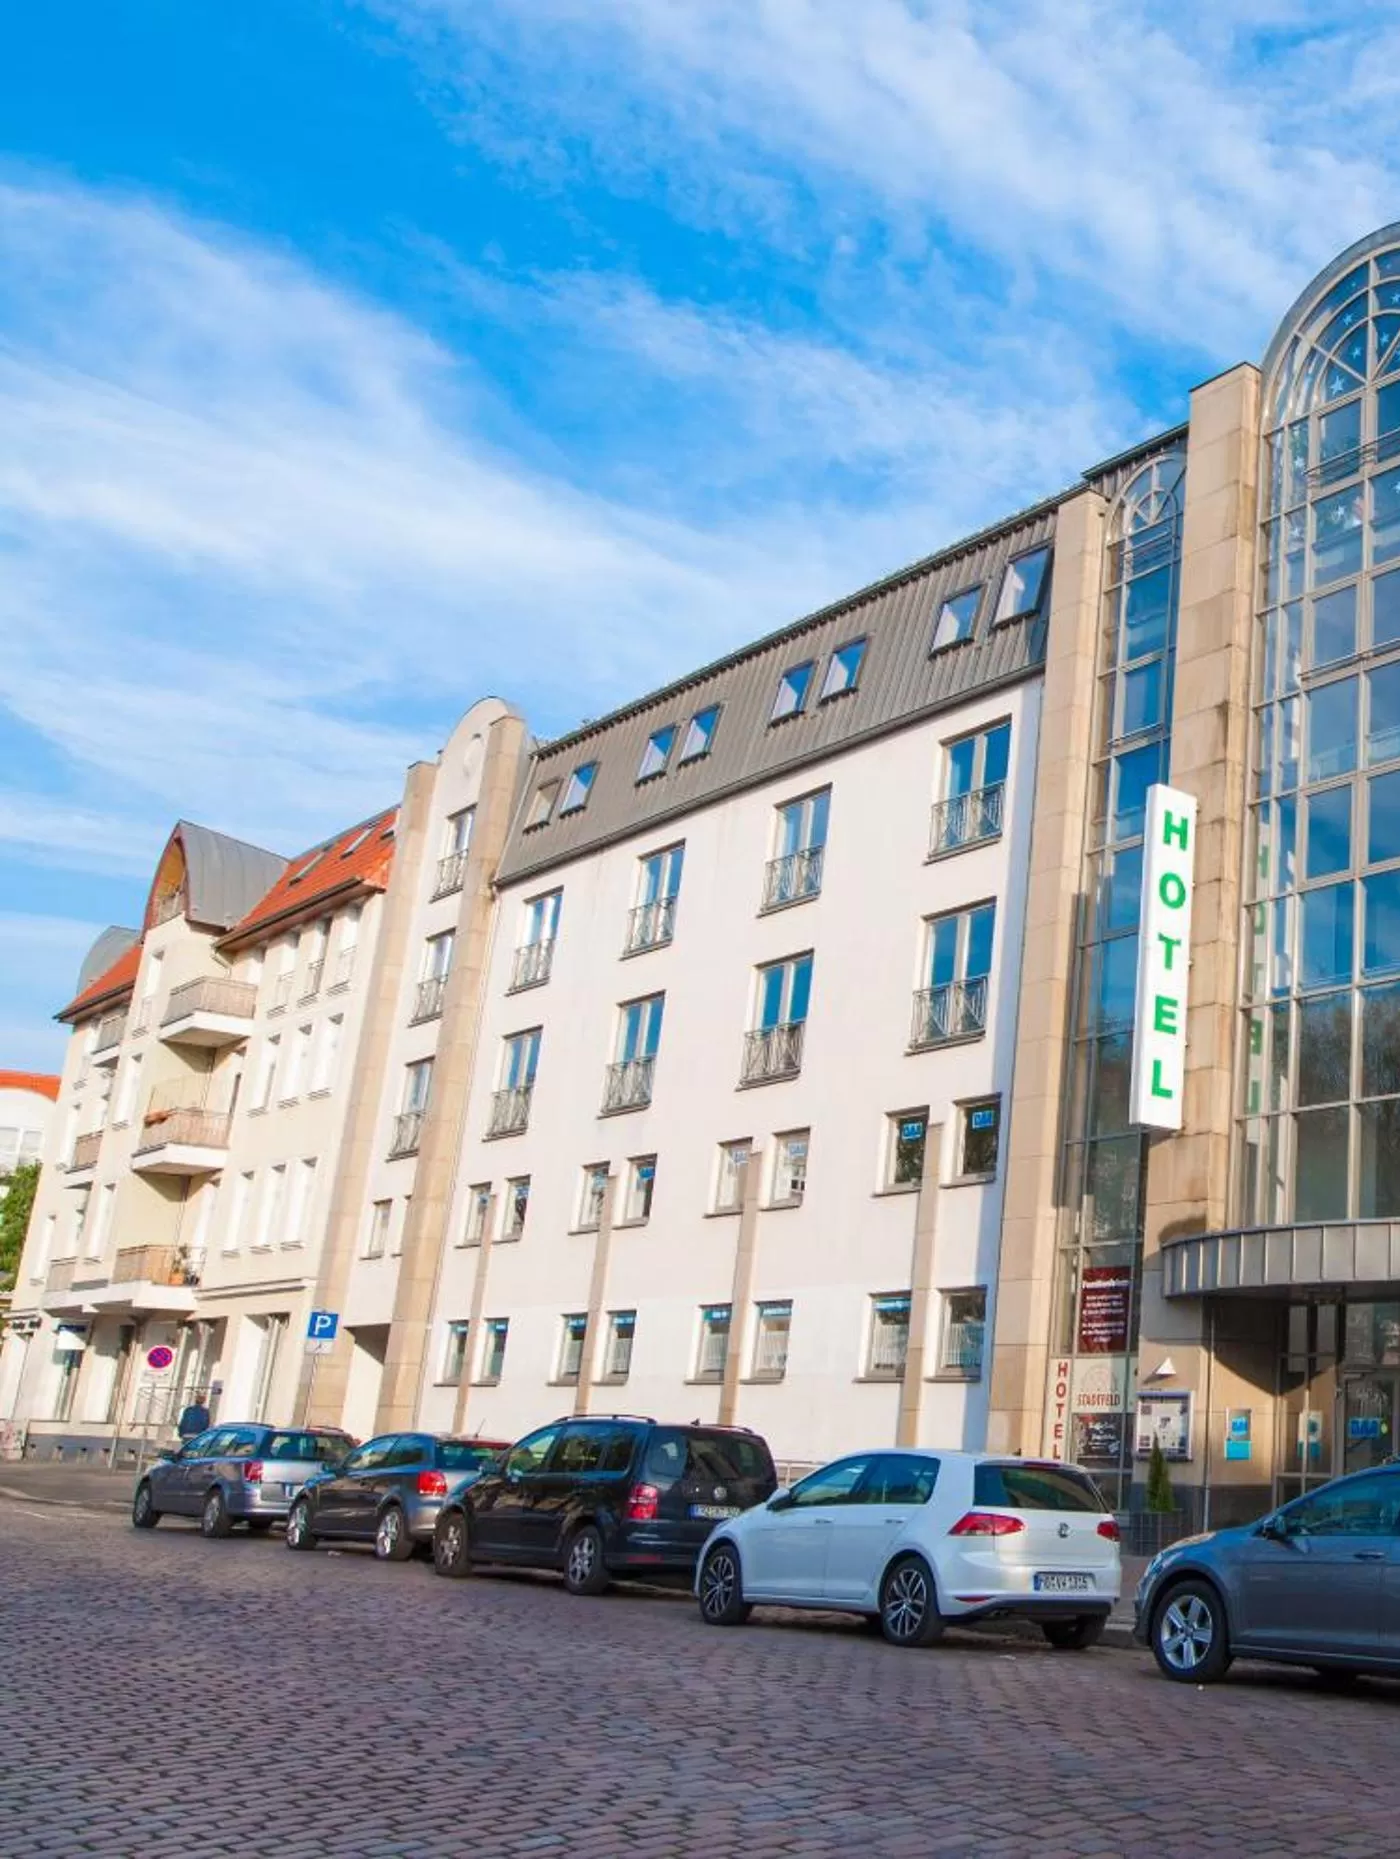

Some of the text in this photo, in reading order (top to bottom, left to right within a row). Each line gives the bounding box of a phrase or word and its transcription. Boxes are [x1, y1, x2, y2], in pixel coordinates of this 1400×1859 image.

[1151, 810, 1189, 1099] HOTEL
[315, 1315, 331, 1336] P
[1052, 1361, 1069, 1460] HOTEL
[1077, 1392, 1121, 1407] STADTFELD
